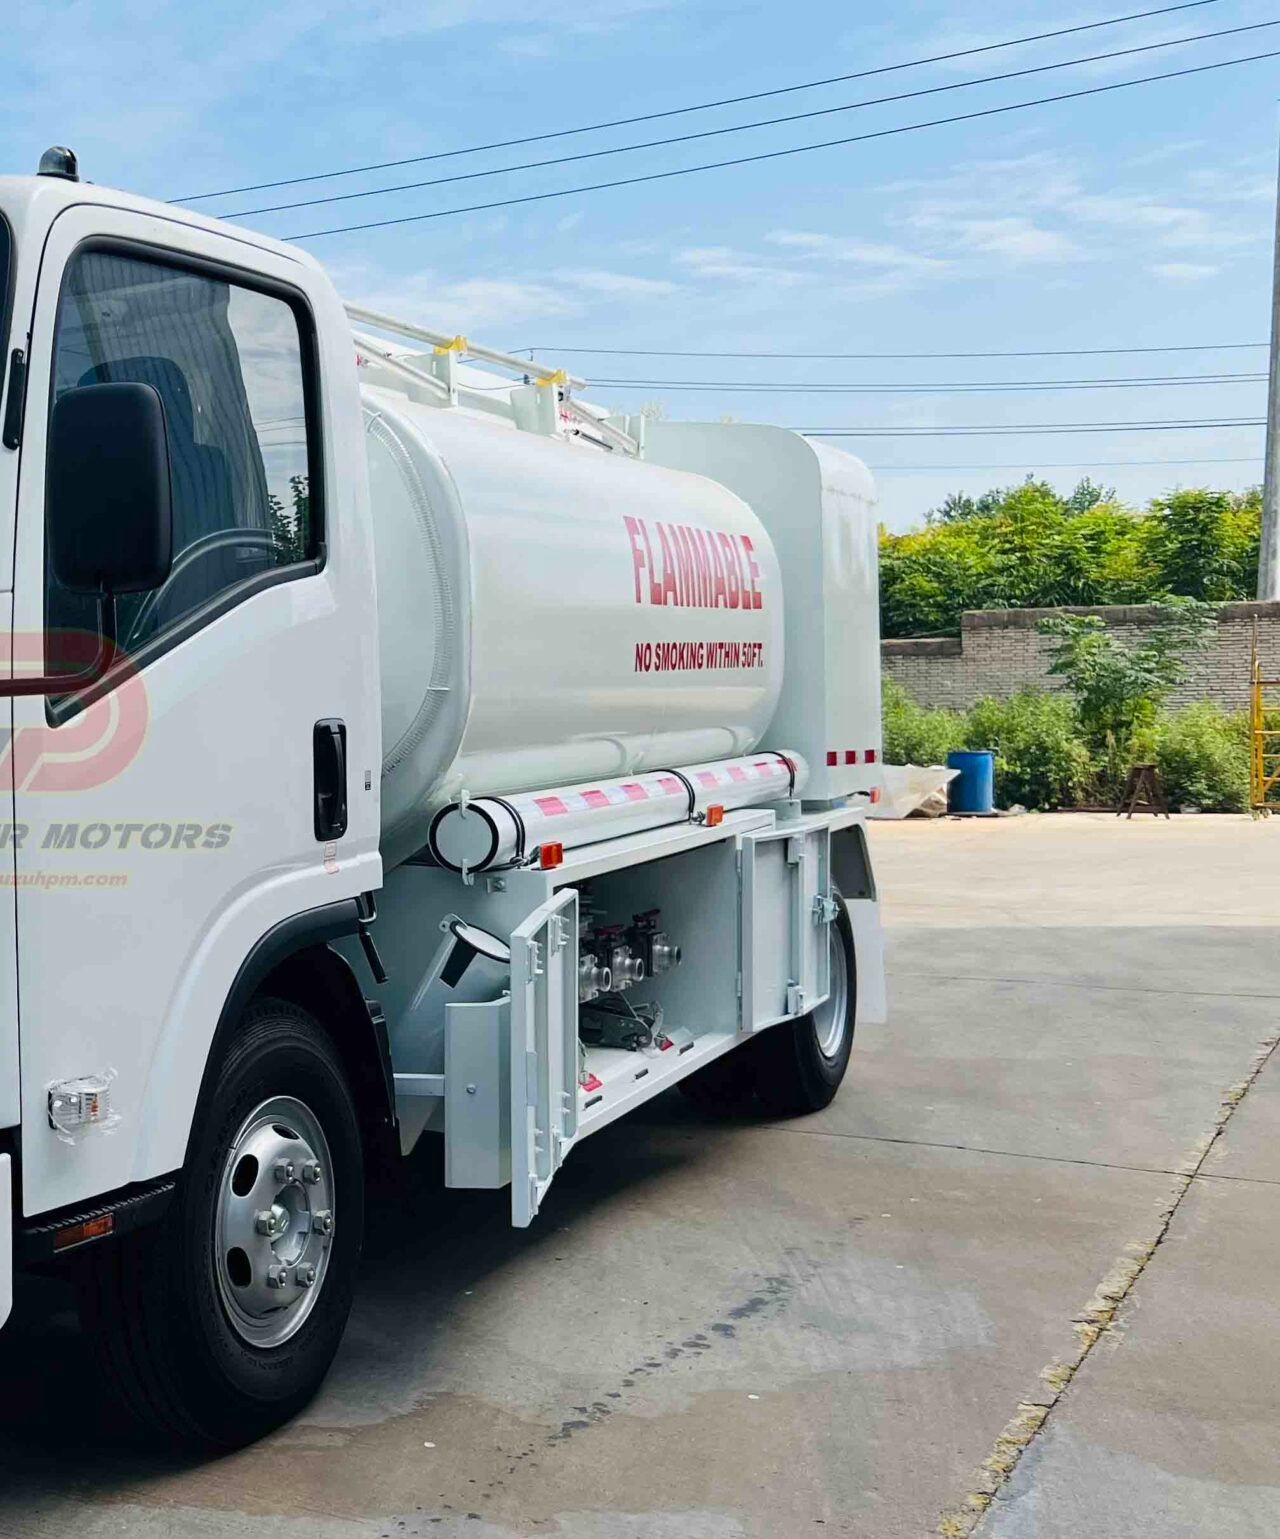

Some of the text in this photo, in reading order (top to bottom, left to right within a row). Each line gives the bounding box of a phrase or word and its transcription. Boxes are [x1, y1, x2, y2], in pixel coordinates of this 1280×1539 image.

[623, 515, 762, 610] FLAMMABLE
[634, 643, 652, 672] NO
[654, 642, 704, 671] SMOKING
[706, 642, 740, 669] WITHIN
